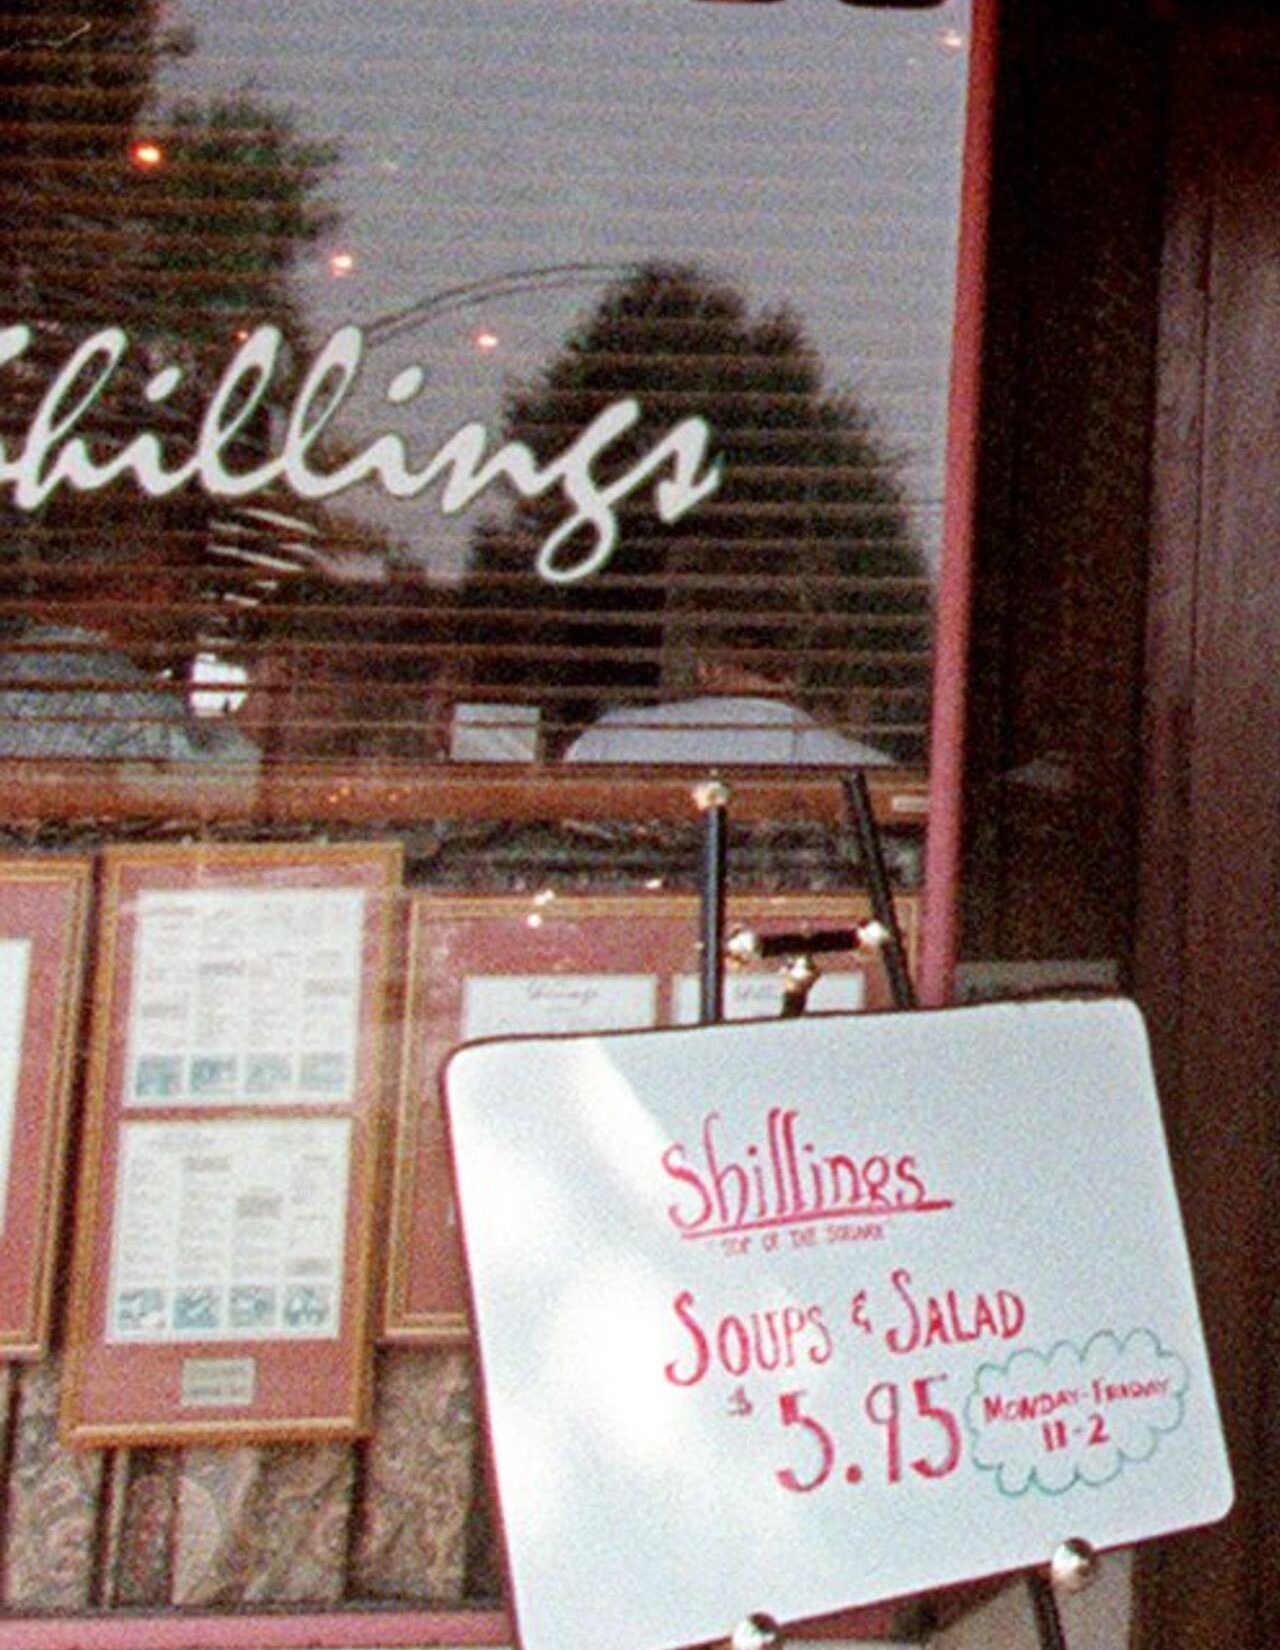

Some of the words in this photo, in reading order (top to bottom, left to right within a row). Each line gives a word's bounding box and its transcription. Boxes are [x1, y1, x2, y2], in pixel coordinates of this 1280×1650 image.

[0, 325, 723, 582] hillings
[661, 1106, 925, 1230] Shillings
[664, 1290, 833, 1387] SOUPS
[884, 1266, 1026, 1354] SALAD
